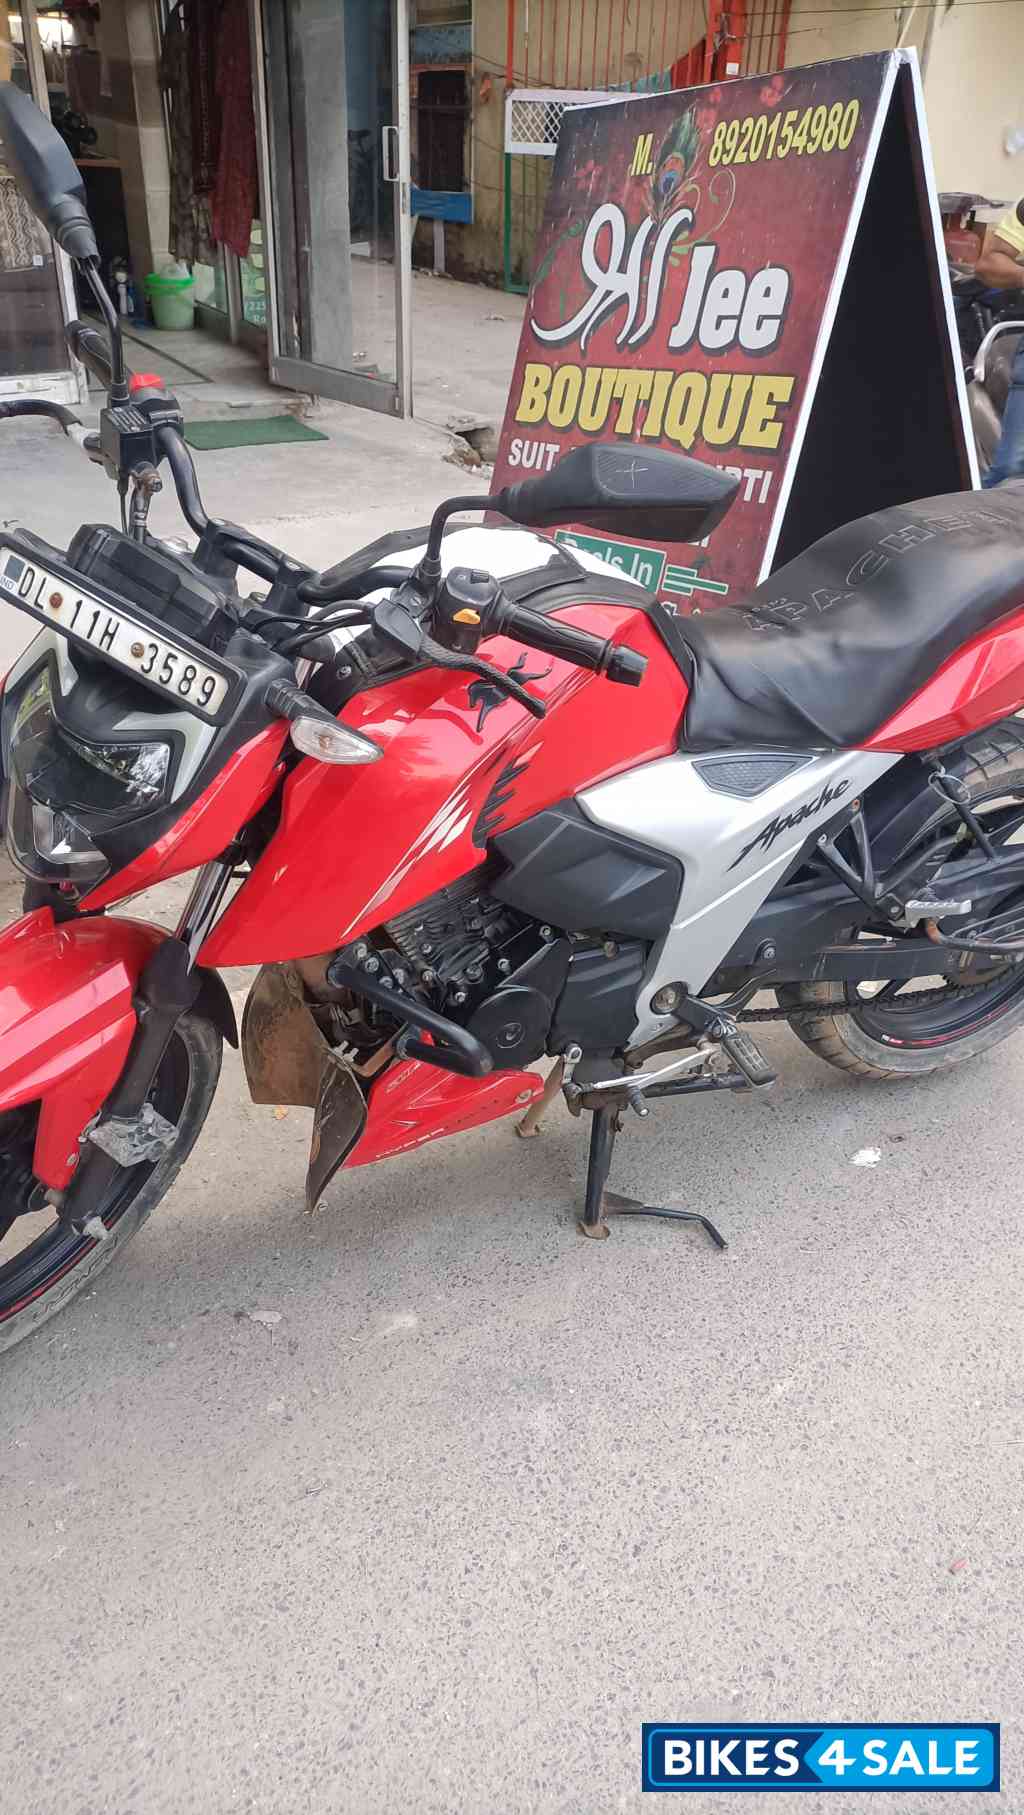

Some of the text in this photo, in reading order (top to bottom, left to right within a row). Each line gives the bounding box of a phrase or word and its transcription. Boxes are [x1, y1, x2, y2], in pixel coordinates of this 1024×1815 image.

[630, 99, 860, 176] M. 8920154980
[669, 245, 790, 350] Jee
[515, 362, 796, 450] BOUTIQUE
[508, 438, 560, 472] SUIT
[630, 552, 653, 586] In
[18, 566, 217, 706] DL 11H 3589
[726, 779, 850, 873] Apache
